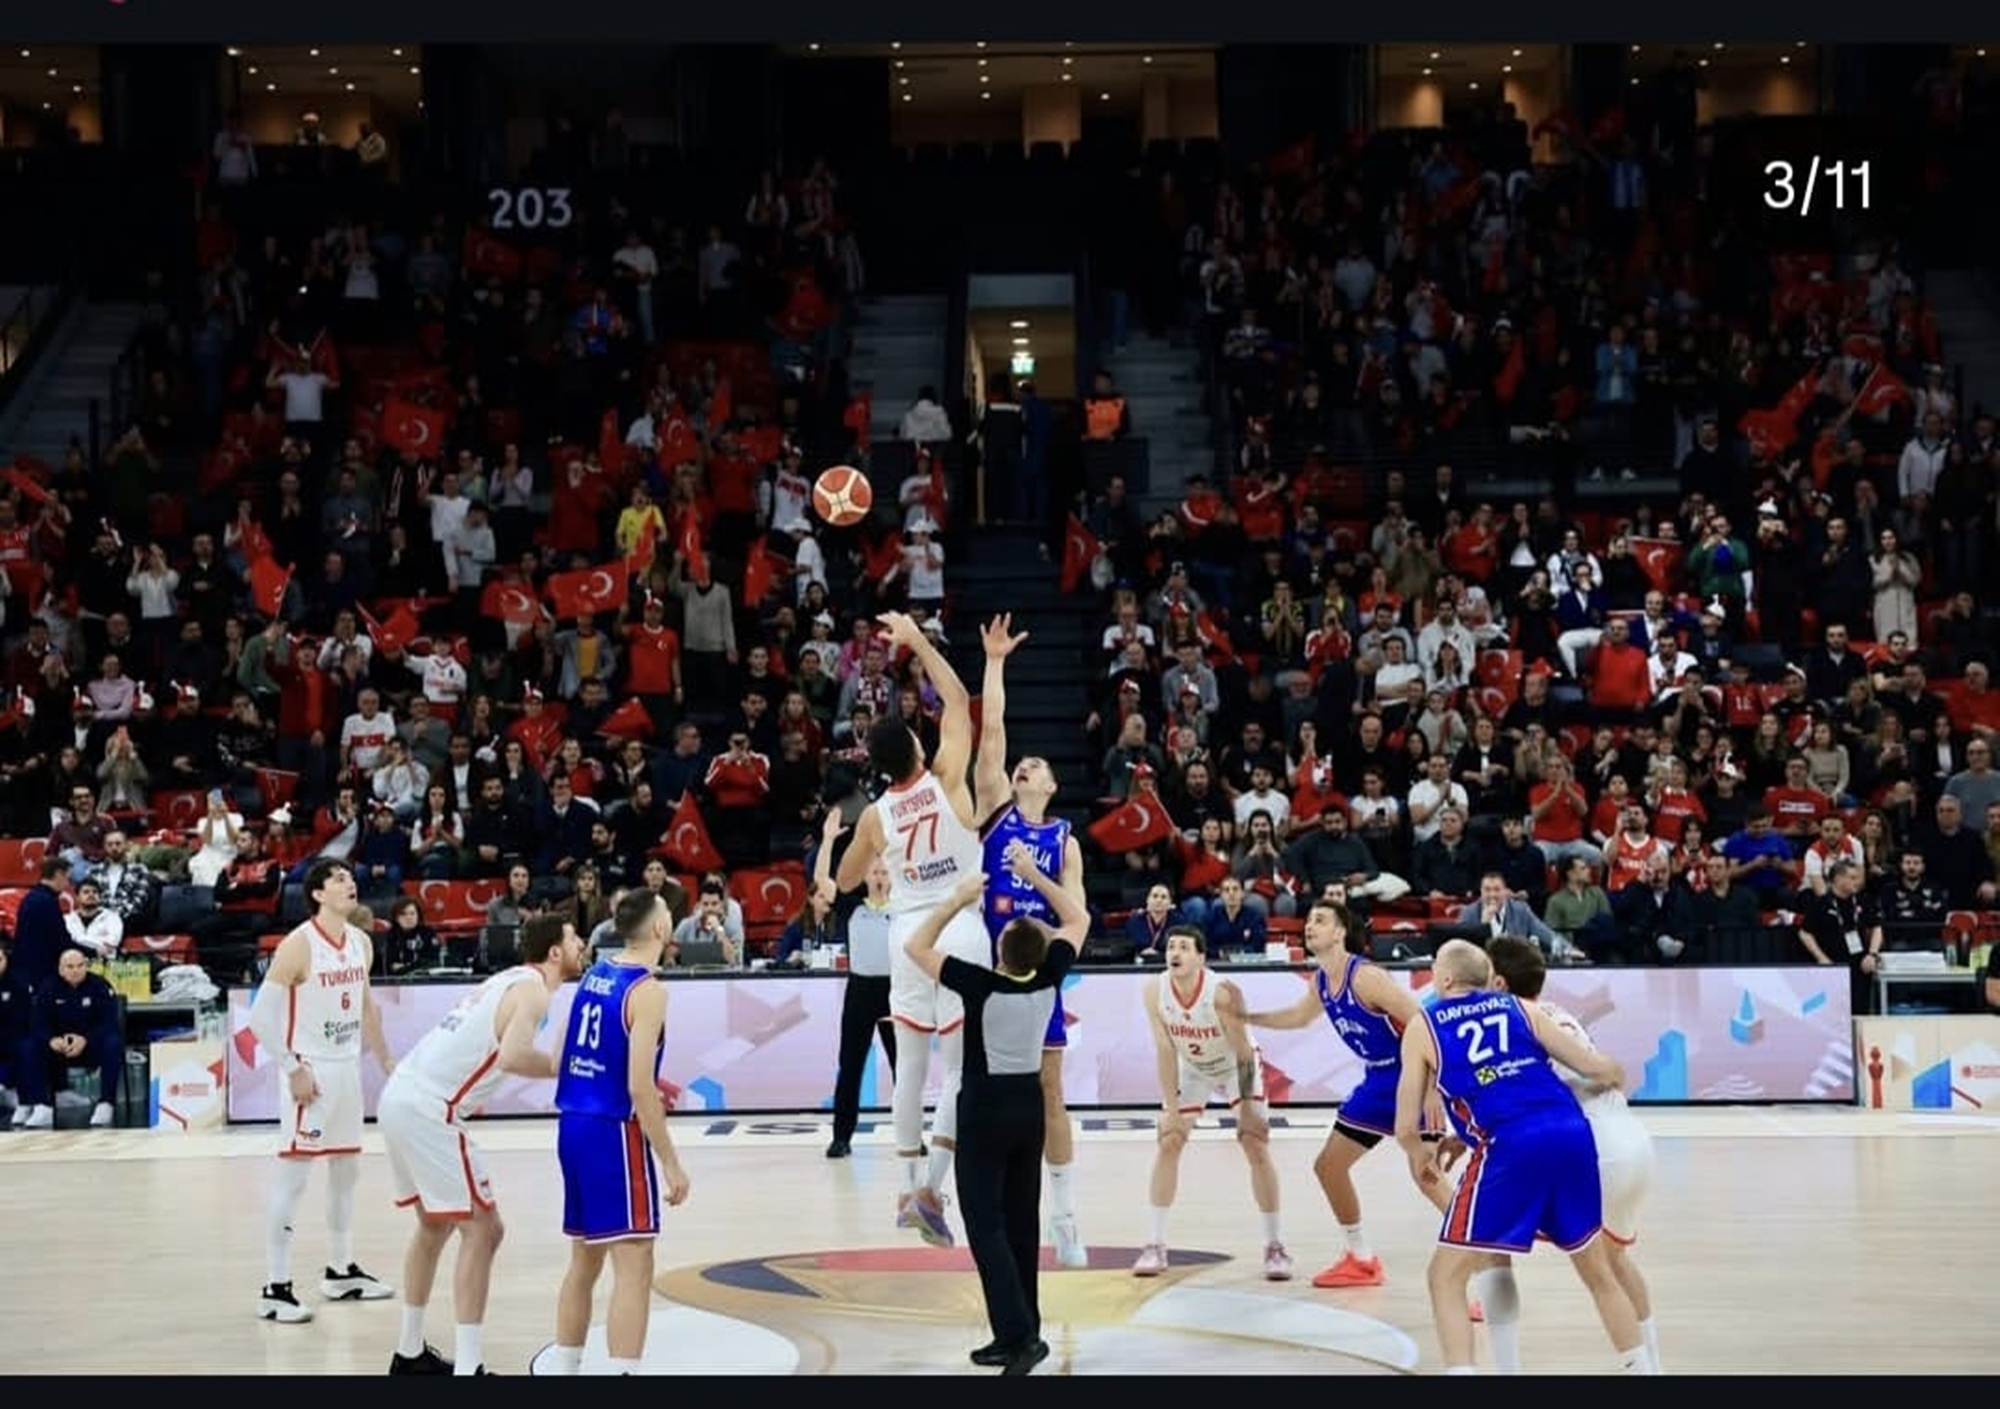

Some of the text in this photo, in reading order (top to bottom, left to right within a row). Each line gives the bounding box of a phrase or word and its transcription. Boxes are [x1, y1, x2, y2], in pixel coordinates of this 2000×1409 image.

[488, 188, 572, 227] 203
[897, 812, 939, 861] 77
[342, 992, 350, 1010] 6
[577, 1001, 602, 1050] 13
[1457, 1013, 1509, 1064] 27
[1188, 1043, 1203, 1056] 2
